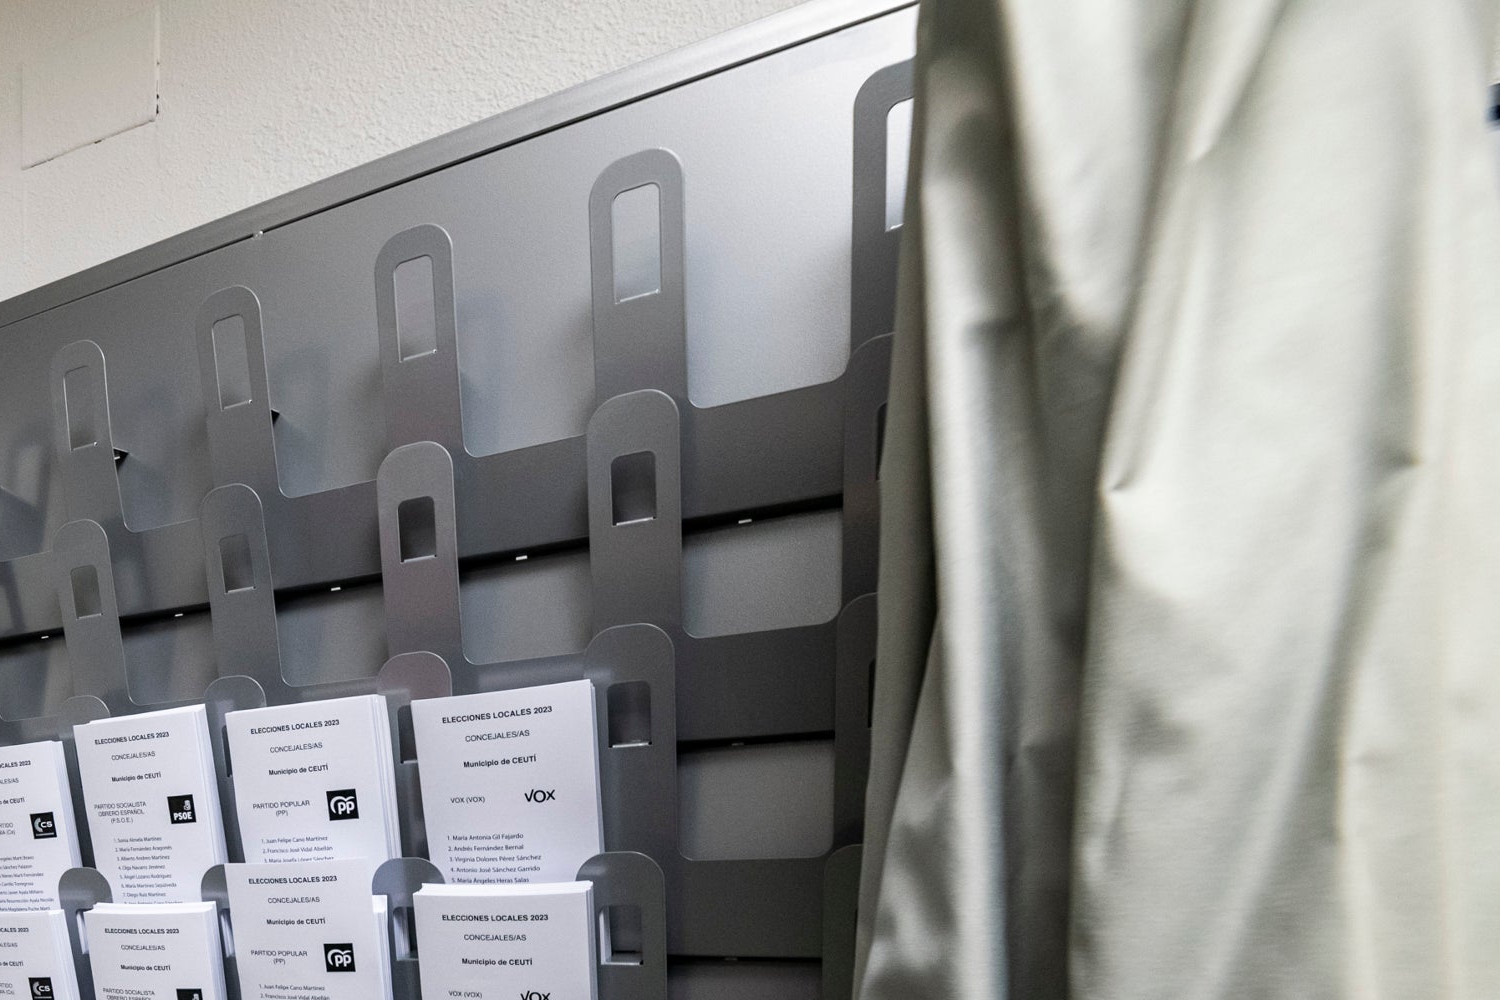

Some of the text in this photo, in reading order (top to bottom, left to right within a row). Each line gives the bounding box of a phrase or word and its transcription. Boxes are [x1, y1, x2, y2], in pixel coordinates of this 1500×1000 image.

[442, 706, 552, 724] ELECCIONES LOCALES 2023
[250, 725, 290, 734] ELECCIONES
[292, 721, 322, 730] LOCALES
[94, 737, 127, 745] ELECCIONES
[128, 733, 155, 741] LOCALES
[465, 730, 530, 742] CONCEJALES/AS
[270, 742, 323, 753] CONCEJALES/AS
[111, 751, 155, 760] CONCEJALES/AS
[525, 789, 555, 803] VOX
[174, 812, 192, 820] PSOE
